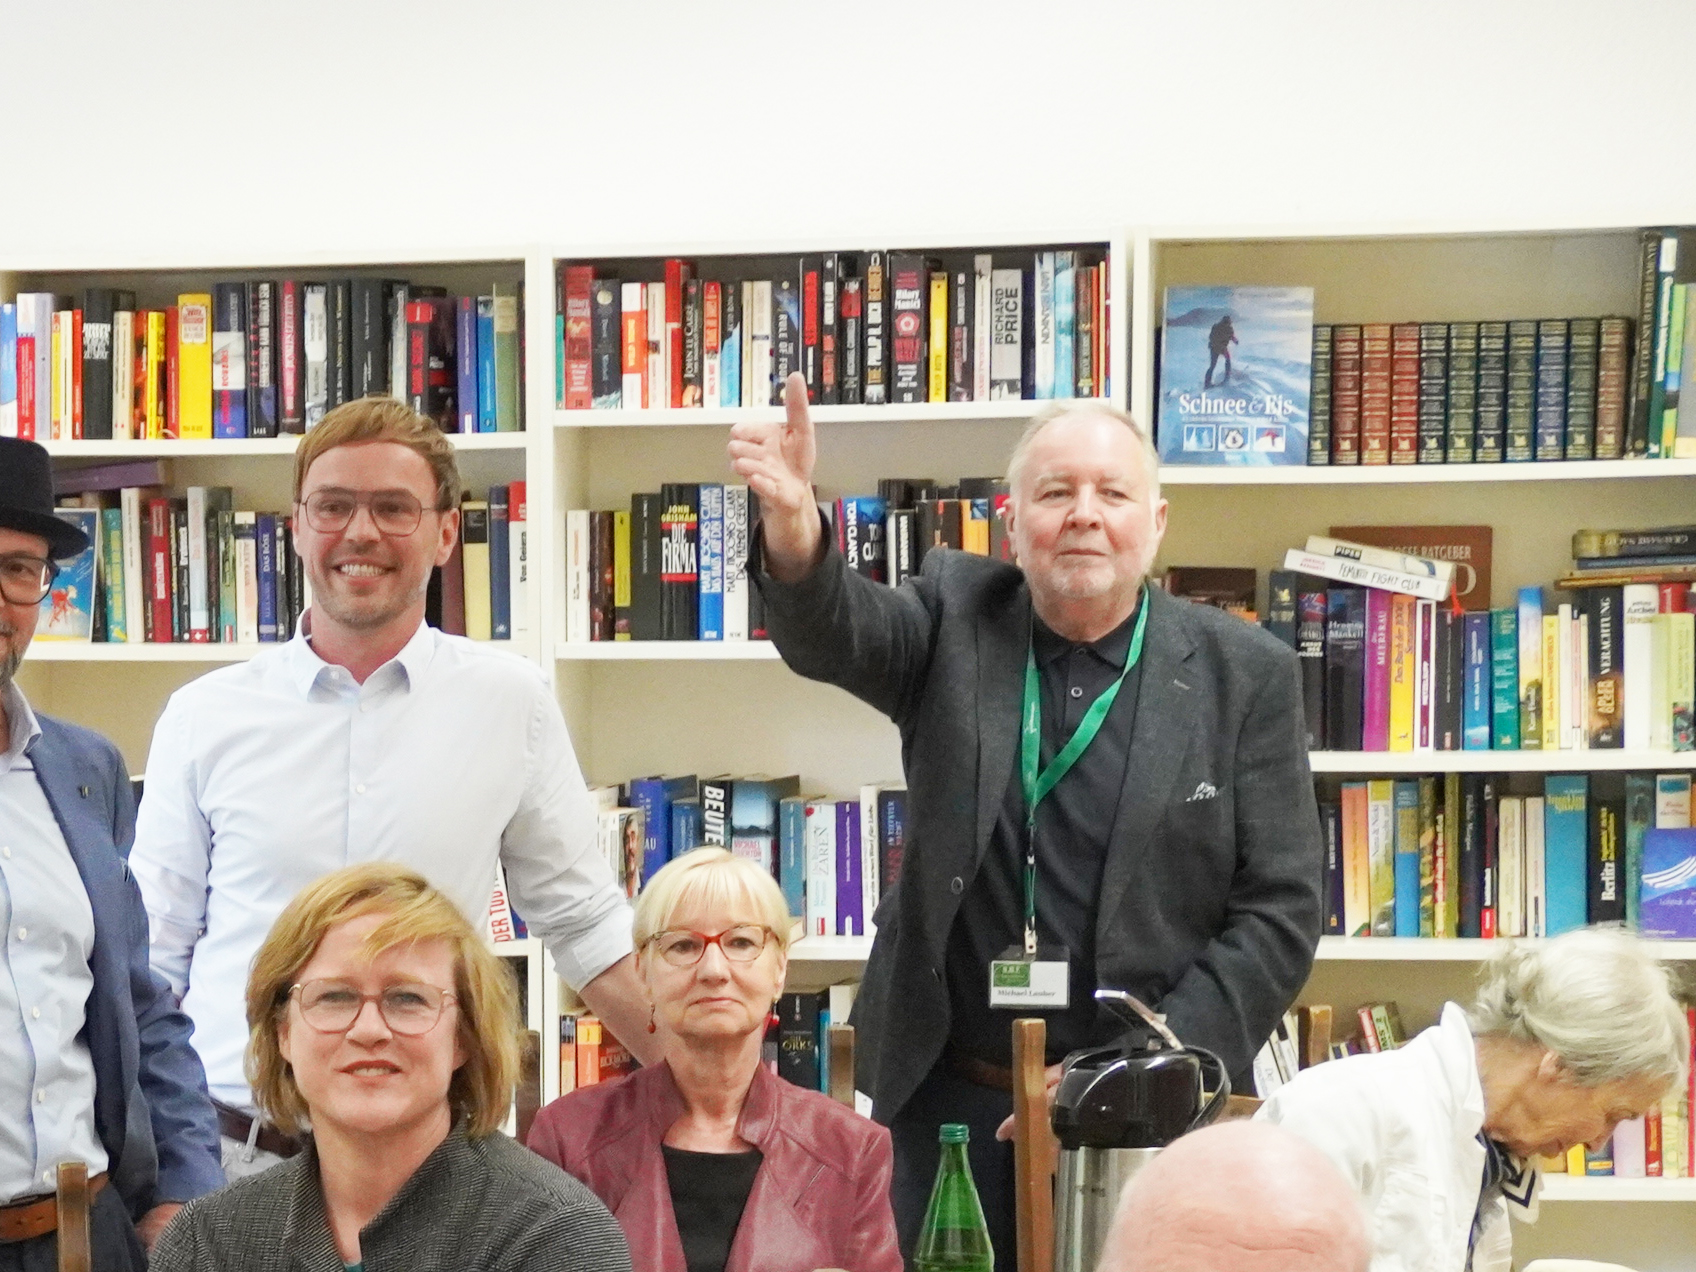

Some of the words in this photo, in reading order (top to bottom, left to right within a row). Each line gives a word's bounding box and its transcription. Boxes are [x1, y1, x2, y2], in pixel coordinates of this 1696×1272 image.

[994, 288, 1004, 345] RICHARD
[1005, 288, 1018, 345] PRICE
[683, 350, 694, 379] JOHN
[1178, 392, 1247, 415] Schnee
[1247, 400, 1264, 415] &
[661, 513, 697, 523] GRISHAM
[668, 504, 690, 513] JOHN
[700, 487, 711, 520] CLARK
[724, 489, 735, 520] CLARK
[735, 489, 746, 526] GESICHT
[846, 501, 857, 526] TOM
[261, 533, 270, 554] BÖSE
[519, 531, 527, 562] Geiern
[671, 523, 687, 543] DIE
[701, 523, 711, 567] HIGGINS
[724, 521, 736, 566] HIGGINS
[736, 528, 746, 558] FREMDE
[847, 526, 859, 570] CLANCY
[262, 555, 270, 572] DAS
[661, 536, 697, 574] FIRMA
[1335, 546, 1361, 560] PIPER
[1421, 545, 1471, 560] RATGEBER
[736, 561, 746, 581] DAS
[1371, 571, 1399, 586] FIGHT
[1401, 578, 1421, 590] CLUB
[1377, 611, 1387, 665] MEERFRAU
[1600, 597, 1611, 675] VERACHTUNG
[1597, 681, 1606, 713] ADLER
[1605, 679, 1615, 713] OLSEN
[704, 785, 725, 846] BEUTE
[817, 825, 828, 875] ZAREN
[1599, 861, 1616, 901] Berlitz
[491, 917, 512, 942] DER
[996, 989, 1027, 997] Michael
